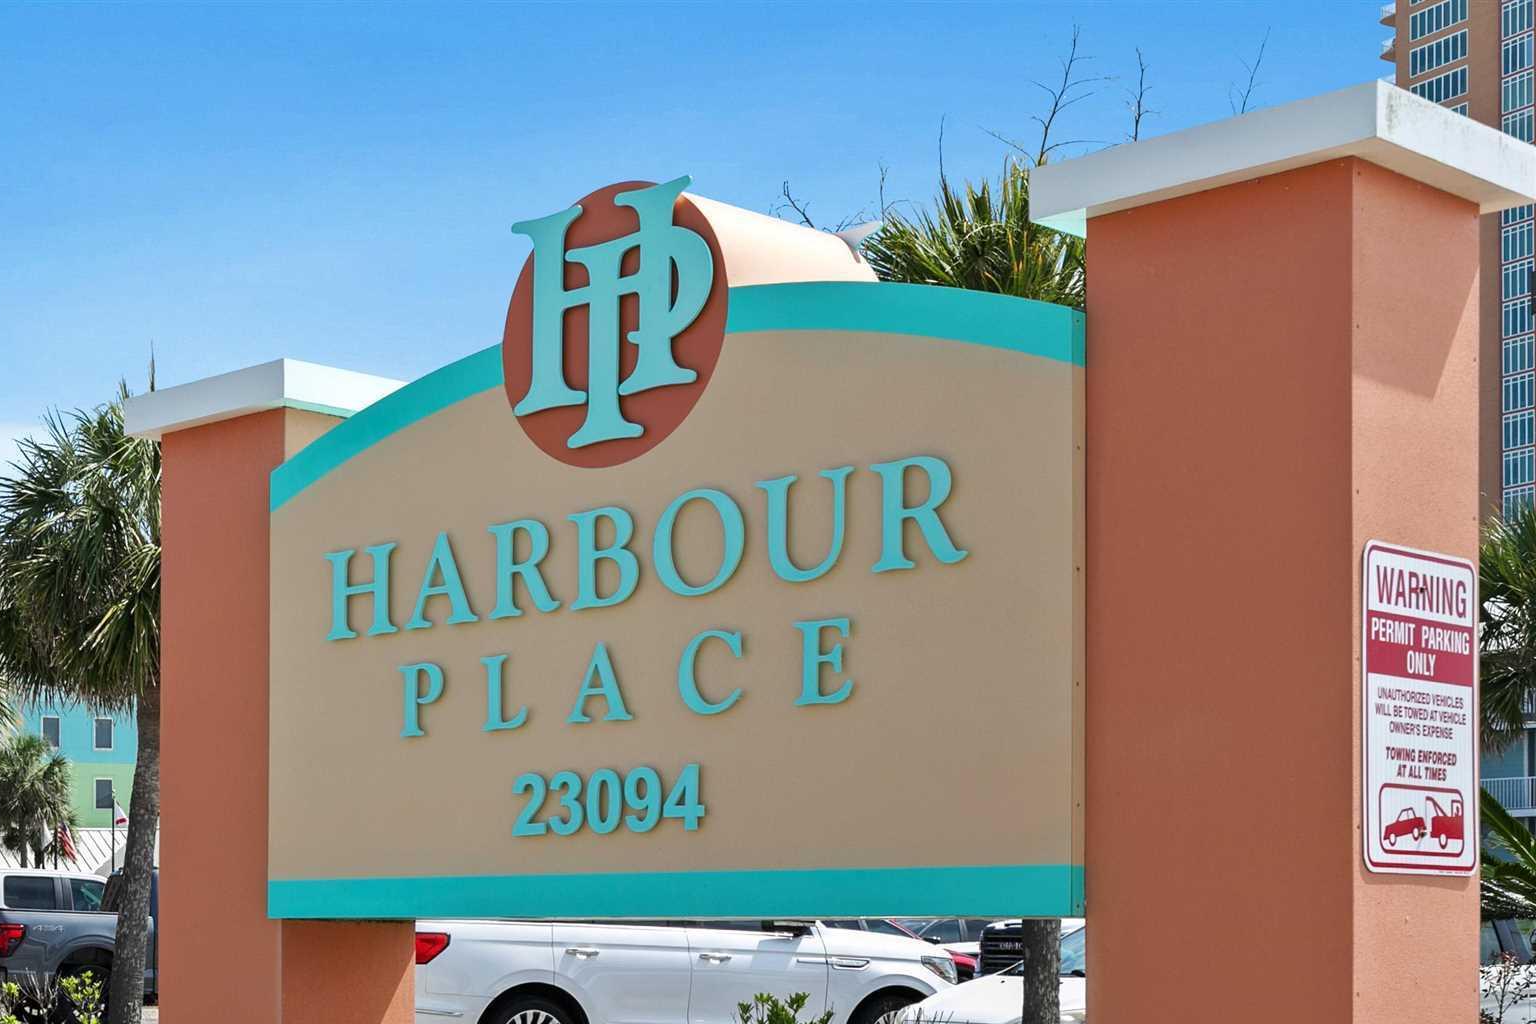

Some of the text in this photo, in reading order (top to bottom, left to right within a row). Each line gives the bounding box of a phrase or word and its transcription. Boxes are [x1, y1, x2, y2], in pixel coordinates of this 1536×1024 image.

[324, 455, 968, 642] HARBOUR
[1375, 564, 1467, 618] WARNING
[1371, 617, 1470, 655] PERMIT PARKING
[1406, 650, 1436, 676] ONLY
[398, 617, 855, 738] PLACE
[1377, 687, 1464, 709] UNAUTHORIZED VEHICLES
[1374, 703, 1466, 725] WILL BE TOWED AT VEHICLE
[1389, 721, 1453, 740] OWNER'S EXPENSE
[1385, 746, 1457, 766] TOWING ENFORCED
[1396, 764, 1447, 781] AT ALL TIMES
[511, 763, 706, 837] 23094
